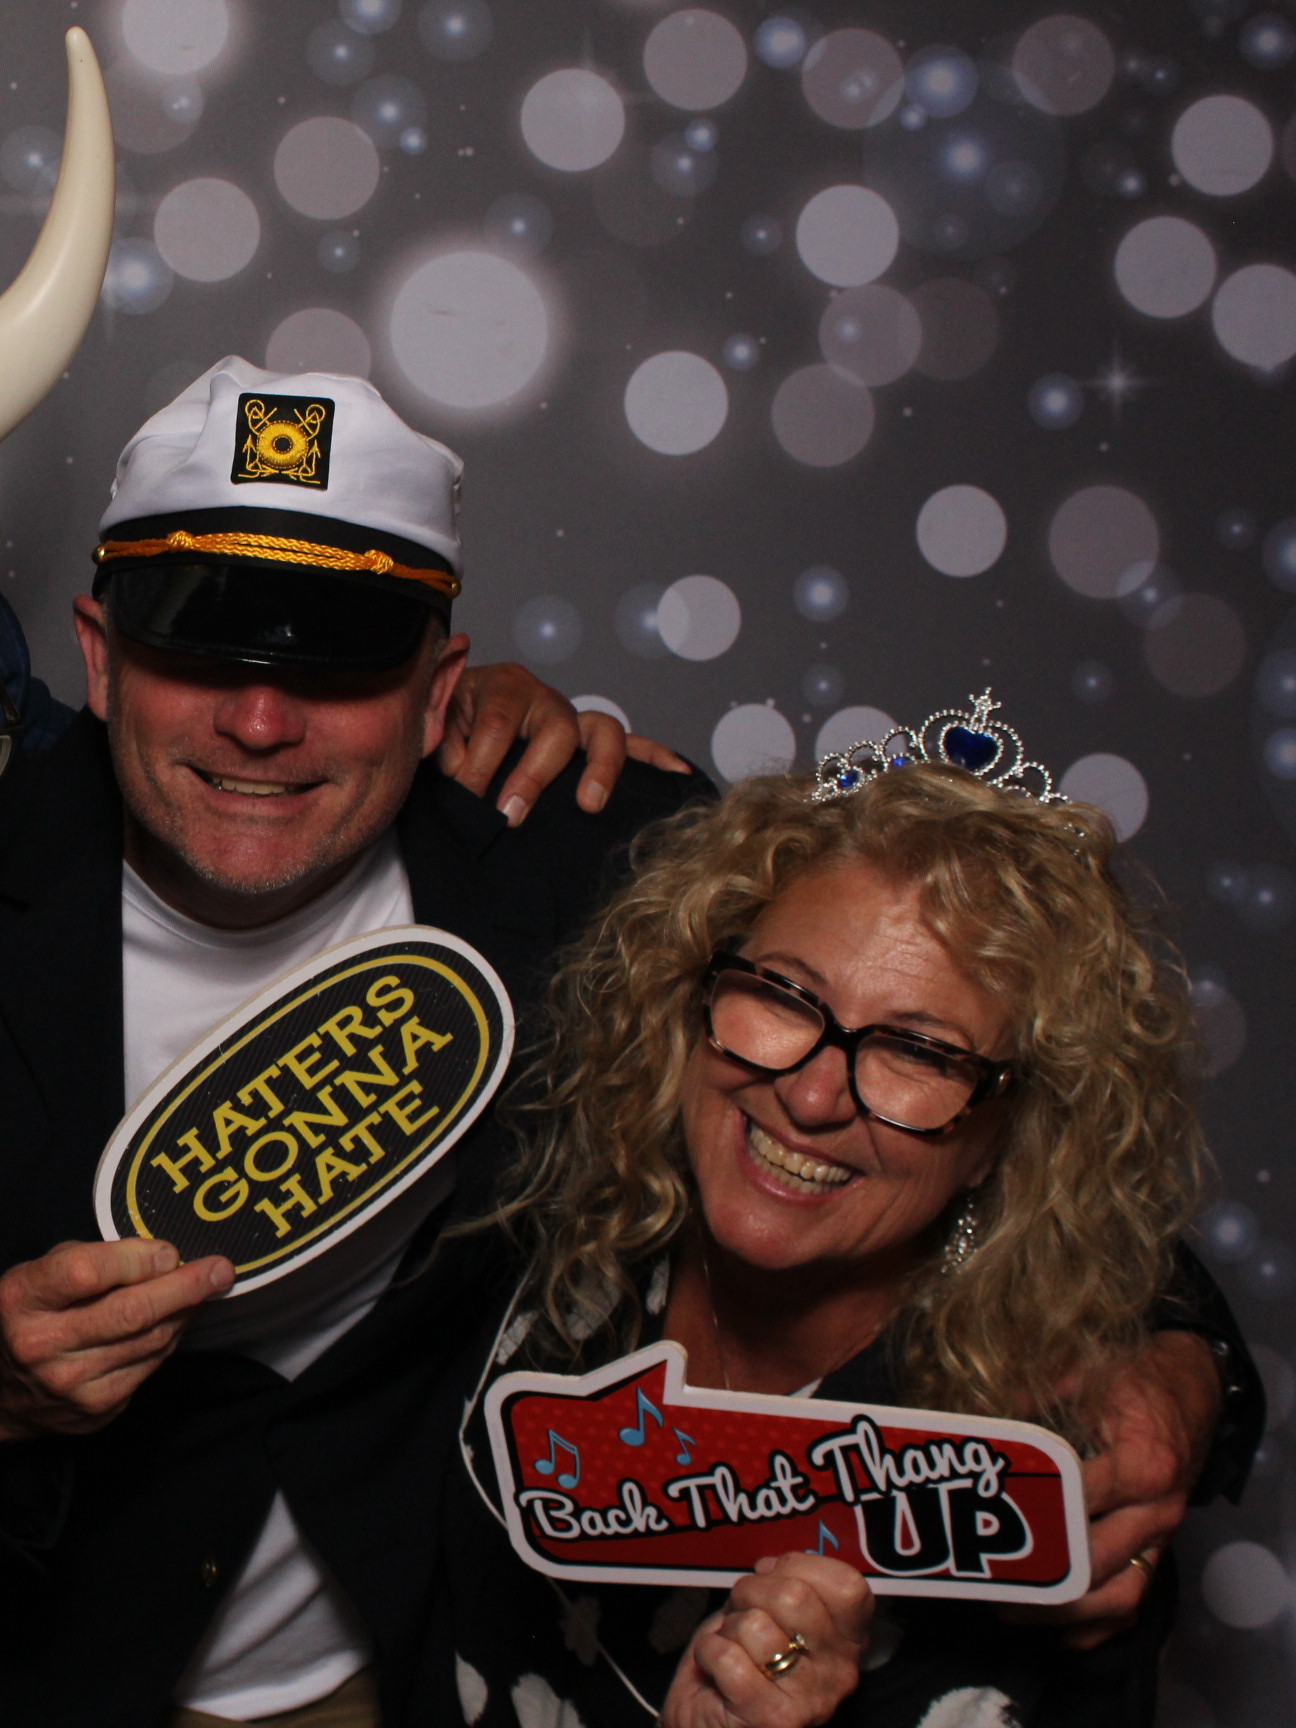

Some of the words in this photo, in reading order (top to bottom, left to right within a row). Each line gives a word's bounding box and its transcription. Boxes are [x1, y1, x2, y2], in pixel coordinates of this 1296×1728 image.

[150, 975, 415, 1194] HATERS
[193, 1016, 453, 1222] GONNA
[254, 1080, 440, 1238] HATE
[519, 1481, 668, 1538] Back
[669, 1457, 814, 1528] That
[812, 1420, 1005, 1504] Thang
[857, 1479, 1033, 1577] UP
